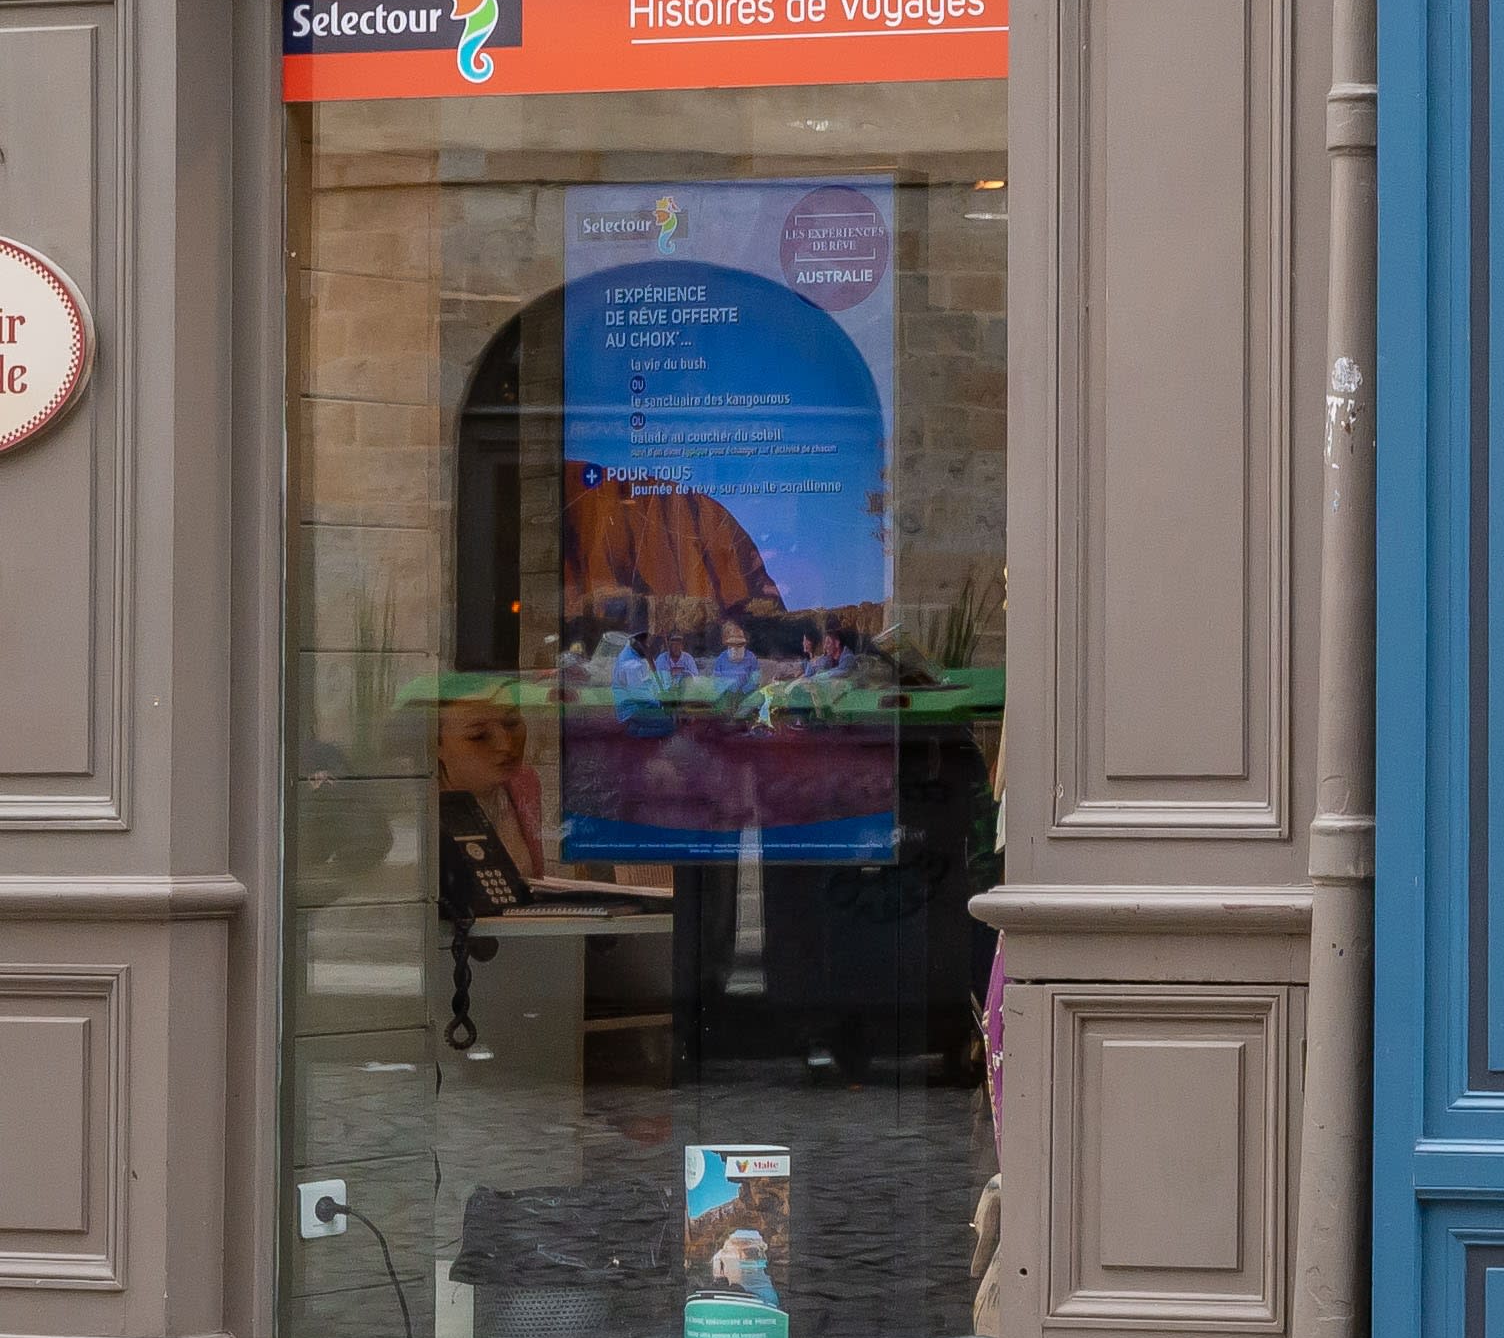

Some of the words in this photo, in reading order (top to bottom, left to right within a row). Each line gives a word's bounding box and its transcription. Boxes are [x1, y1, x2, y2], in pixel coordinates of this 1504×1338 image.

[292, 1, 442, 38] Selectour
[583, 216, 652, 234] Selectour
[785, 228, 804, 240] LES
[812, 240, 830, 251] DE
[796, 269, 873, 283] AUSTRALIE
[614, 284, 707, 303] EXPÉRIENCE
[605, 311, 626, 326] DE
[629, 307, 668, 325] RÊVE
[671, 307, 738, 324] OFFERTE
[605, 333, 626, 348] AU
[631, 359, 641, 370] la
[644, 359, 660, 370] vie
[664, 358, 677, 370] du
[681, 357, 706, 370] bush
[631, 395, 641, 408] le
[644, 395, 701, 407] sanctuaire
[705, 394, 723, 406] des
[726, 393, 790, 408] kangourous
[631, 431, 668, 444] balade
[687, 431, 731, 443] coucher
[734, 430, 748, 442] du
[752, 429, 781, 441] soleil
[607, 467, 648, 481] POUR
[651, 466, 692, 481] TOUS
[631, 483, 672, 498] journée
[675, 483, 689, 495] de
[719, 483, 736, 494] sur
